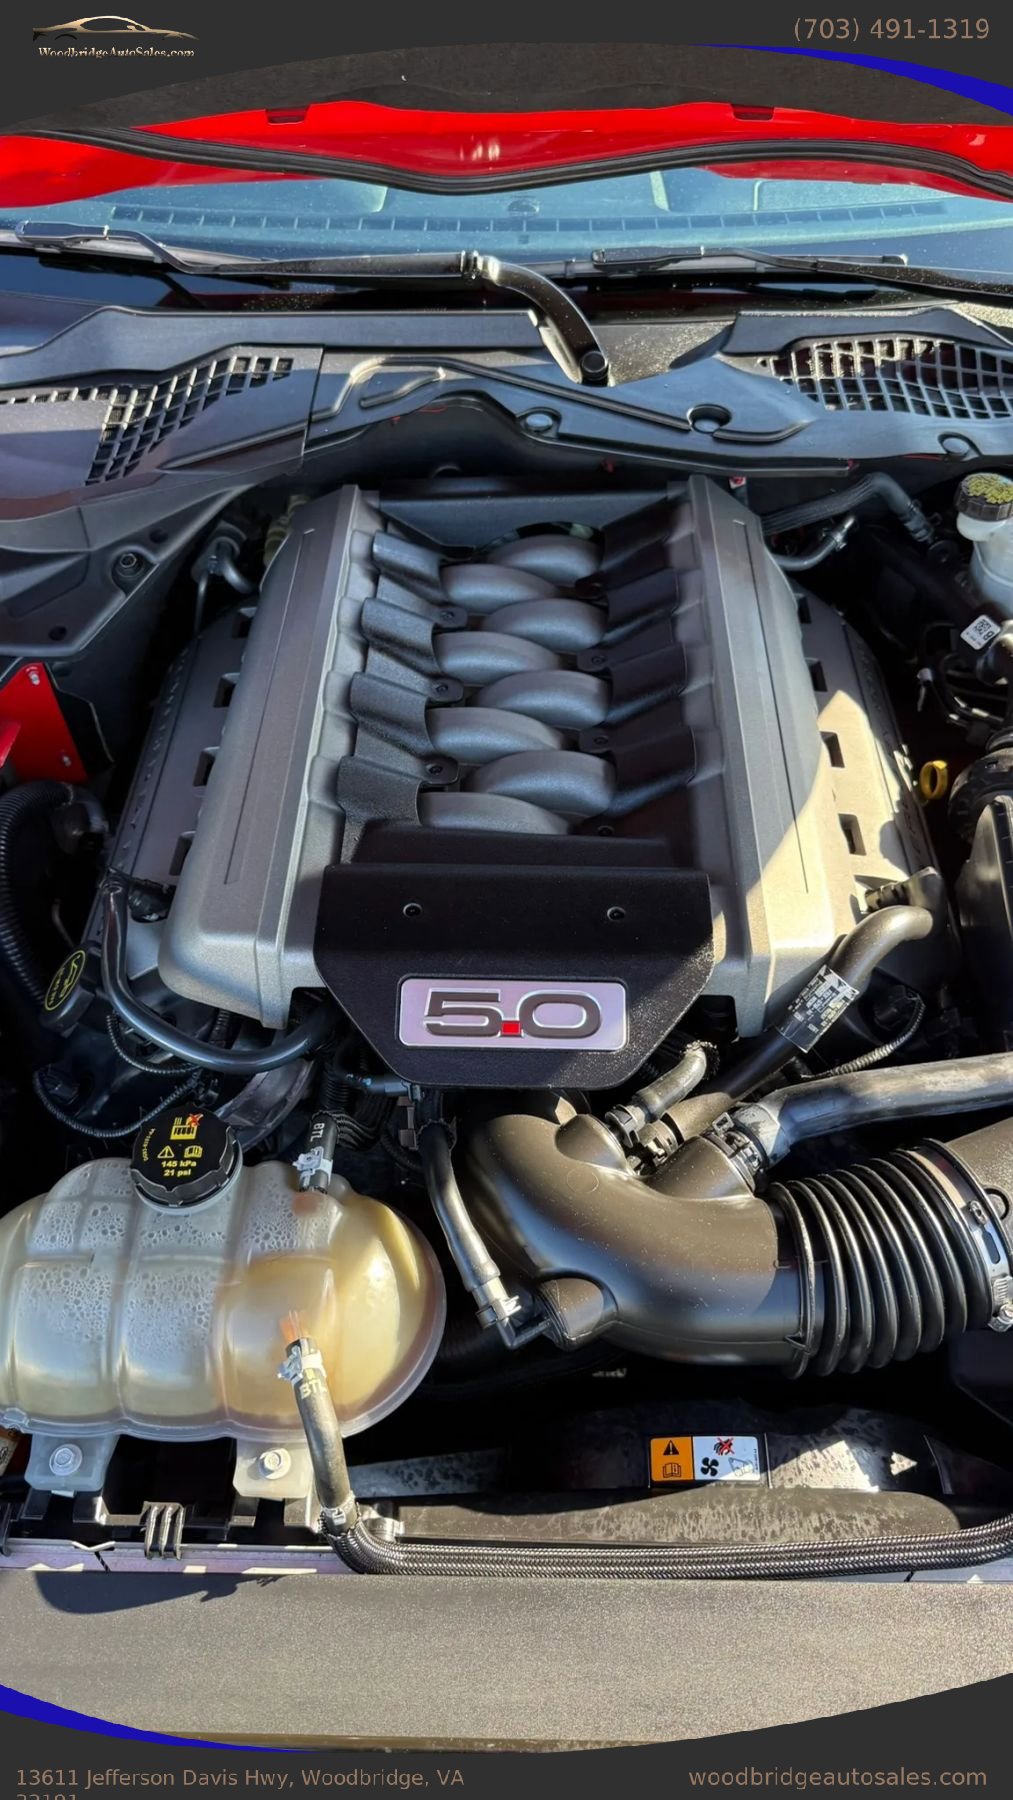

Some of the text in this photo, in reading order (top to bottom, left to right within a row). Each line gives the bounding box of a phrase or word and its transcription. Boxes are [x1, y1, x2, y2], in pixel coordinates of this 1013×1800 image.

[423, 988, 602, 1039] 5.0
[310, 1122, 326, 1143] BTL
[179, 1160, 197, 1168] kPa
[177, 1169, 192, 1178] psi
